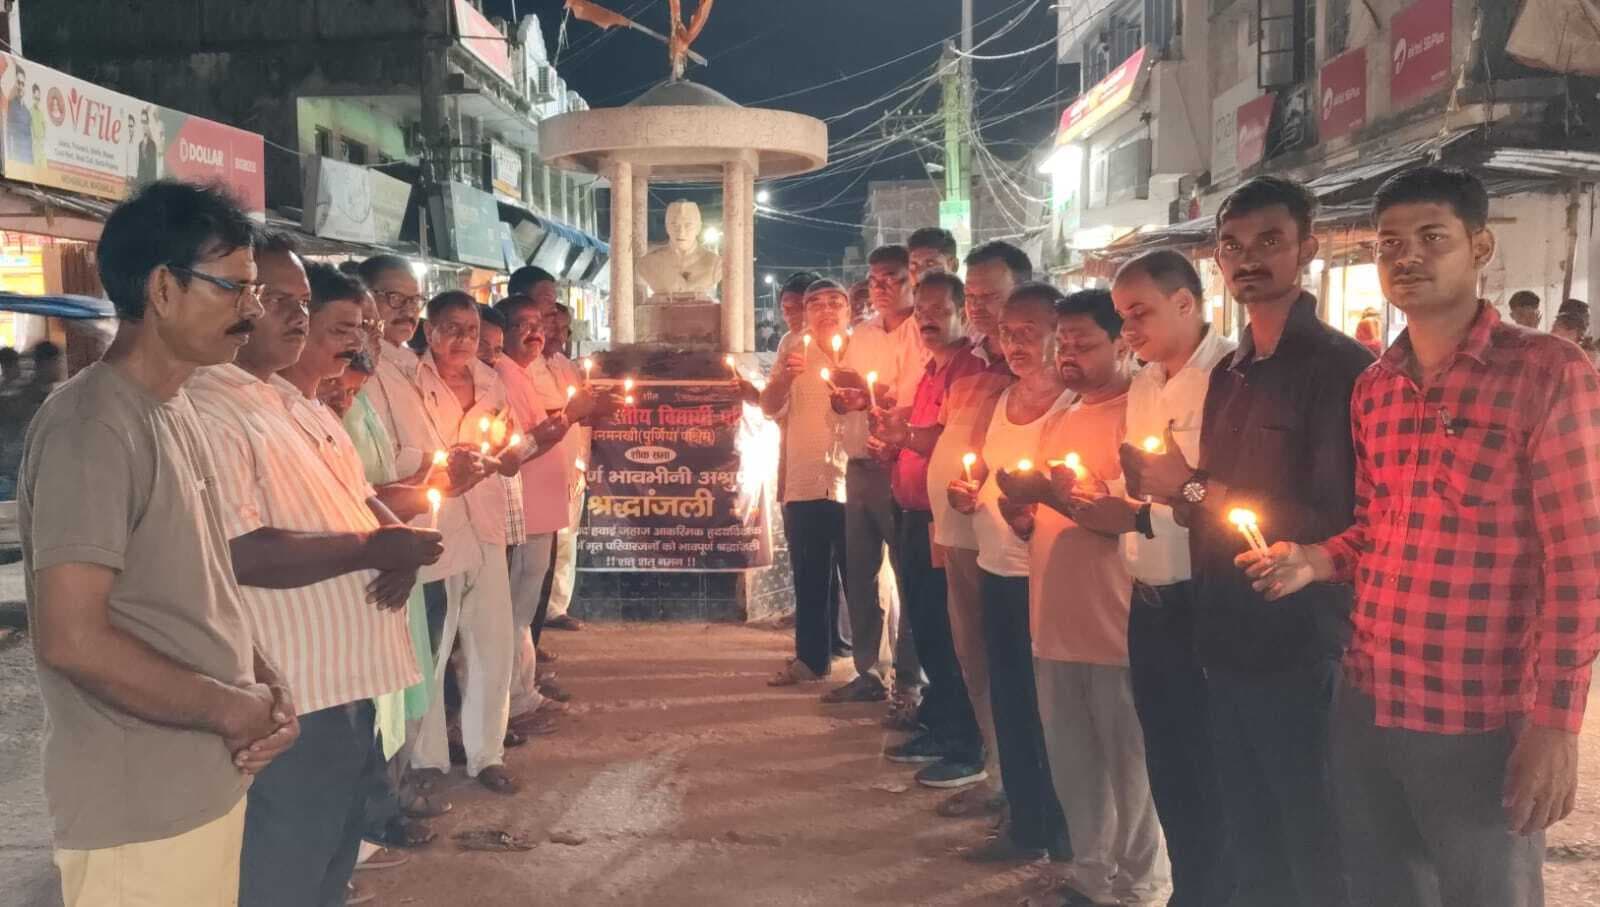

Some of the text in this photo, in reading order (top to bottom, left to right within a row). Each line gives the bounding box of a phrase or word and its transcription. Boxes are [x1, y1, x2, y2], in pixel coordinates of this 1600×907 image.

[189, 142, 224, 167] DOLLAR
[609, 465, 692, 485] भावभीनी
[588, 487, 715, 518] श्रद्धांजली
